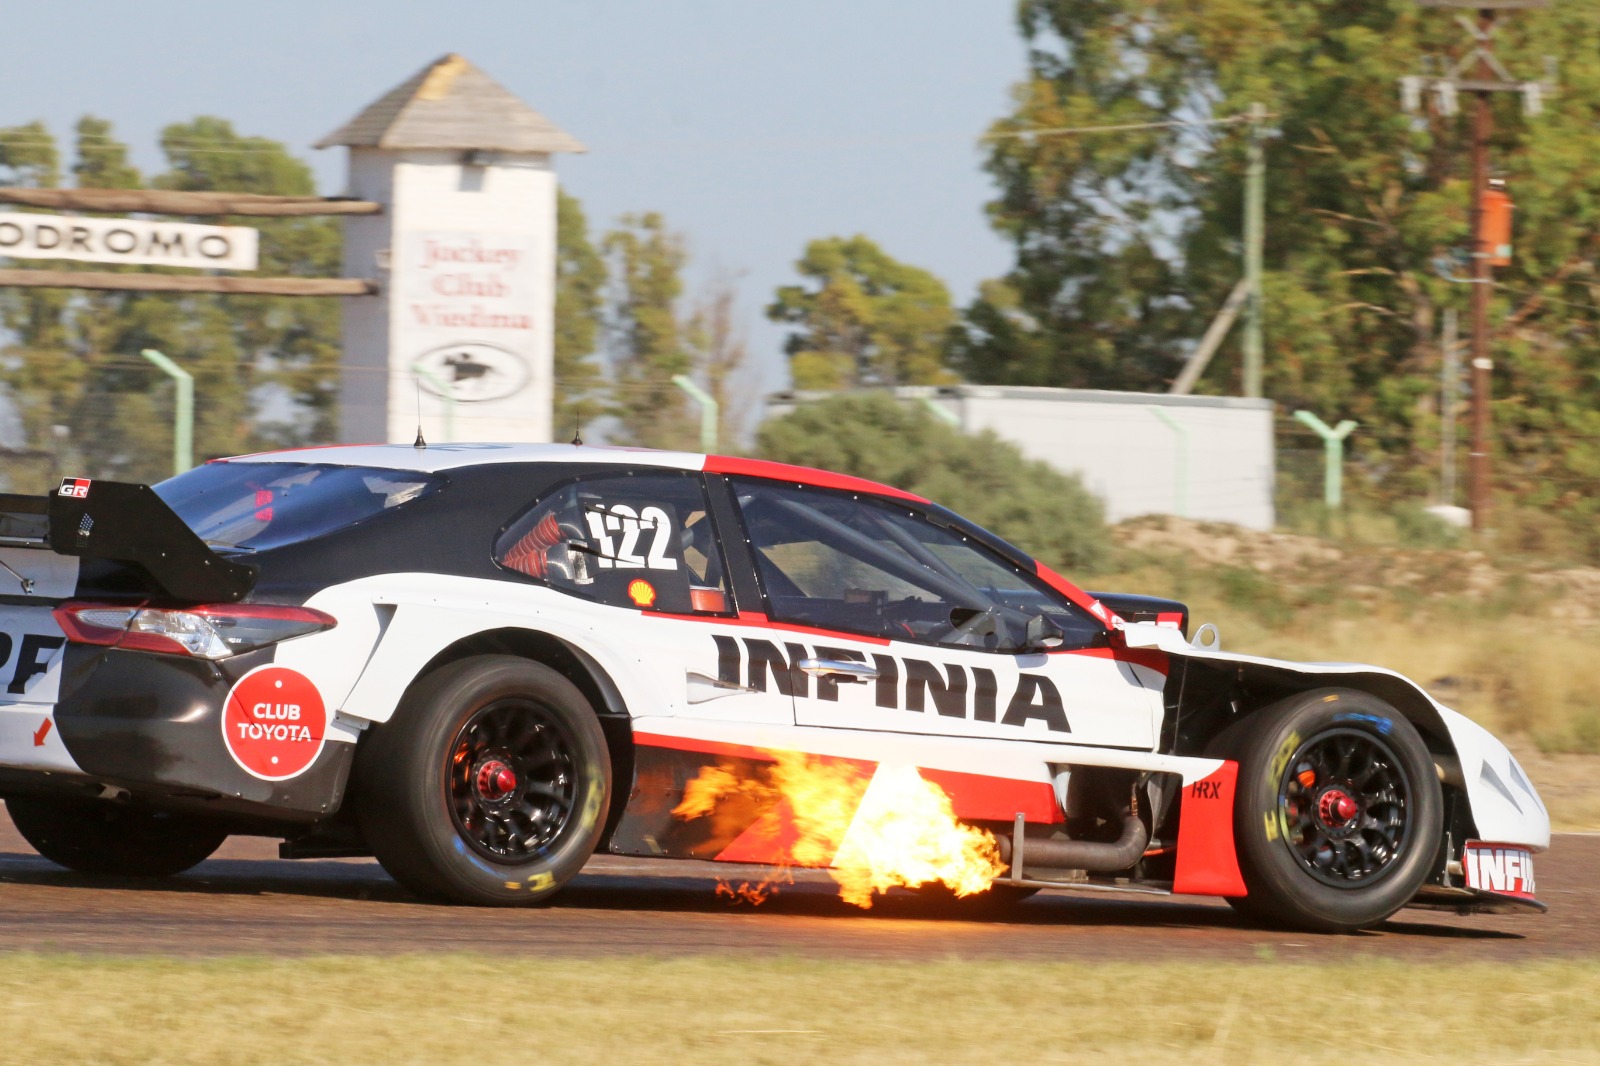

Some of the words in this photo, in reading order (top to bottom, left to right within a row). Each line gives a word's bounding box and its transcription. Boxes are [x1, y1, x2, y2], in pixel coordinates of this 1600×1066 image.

[417, 239, 520, 270] Jockey
[431, 272, 511, 297] Club
[60, 484, 88, 497] GR
[585, 503, 678, 570] 122
[0, 631, 66, 695] F
[711, 634, 1072, 734] INFINIA
[253, 703, 301, 720] CLUB
[237, 723, 312, 742] TOYOTA
[1191, 781, 1222, 799] HRX
